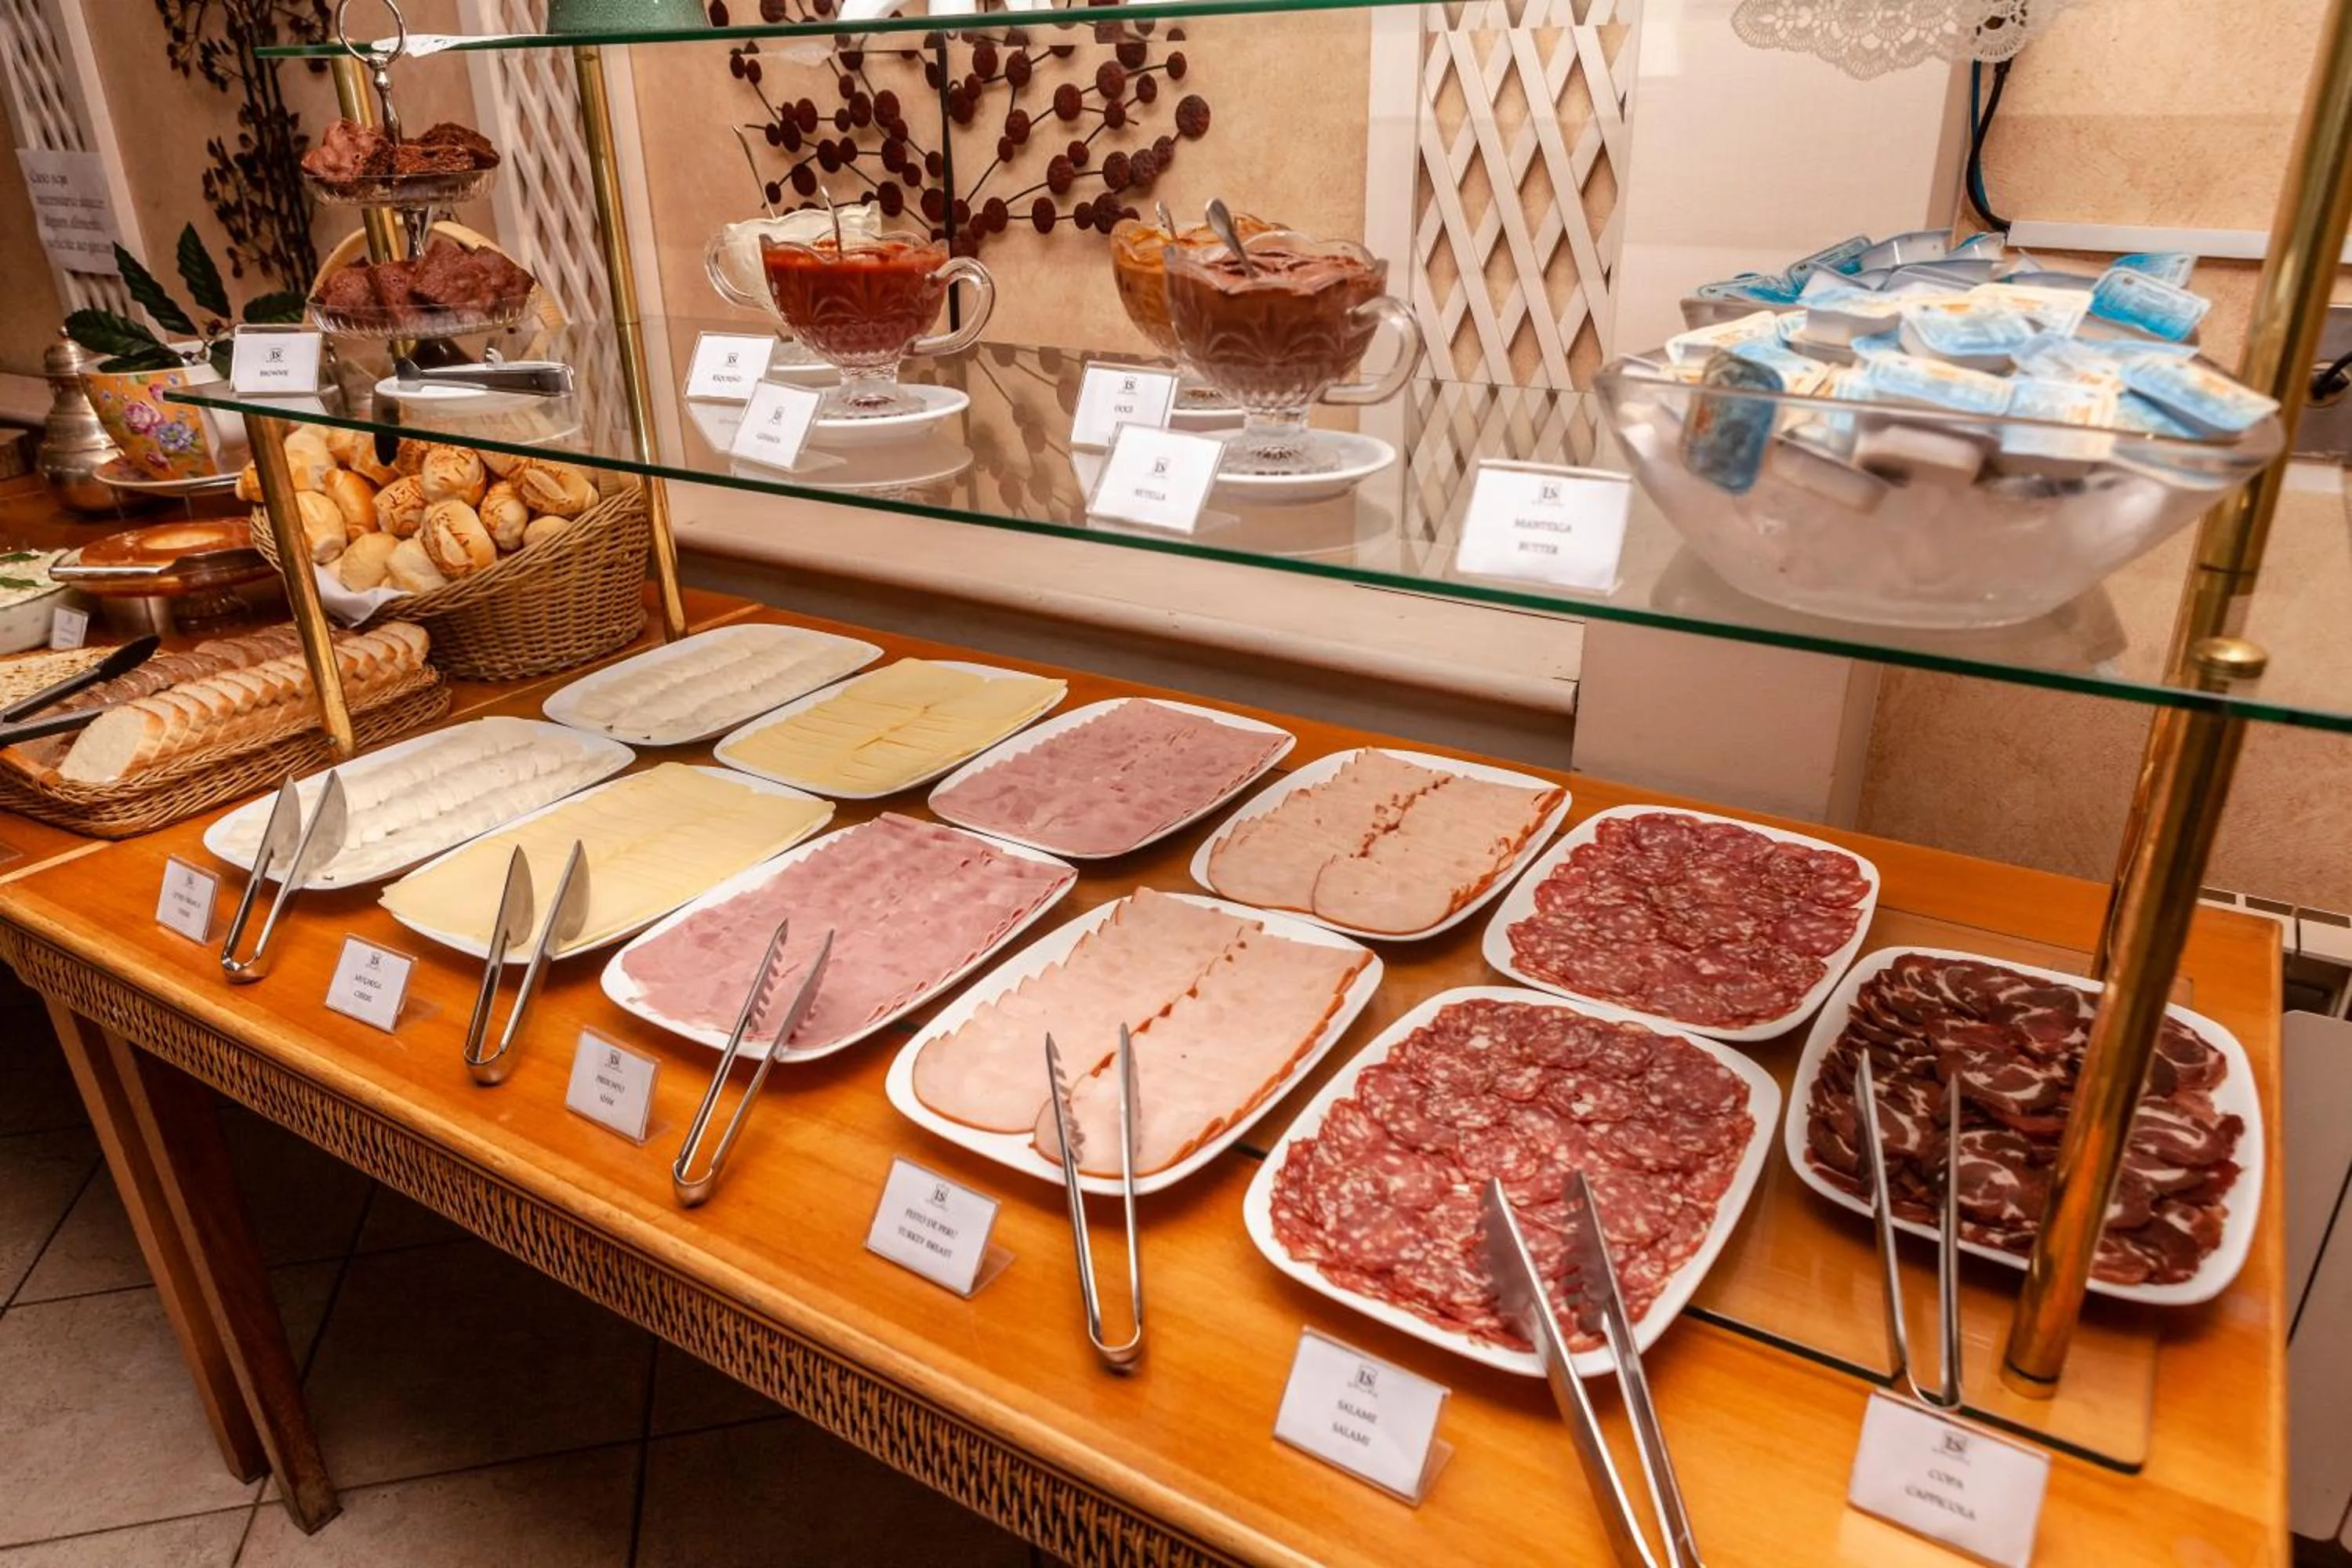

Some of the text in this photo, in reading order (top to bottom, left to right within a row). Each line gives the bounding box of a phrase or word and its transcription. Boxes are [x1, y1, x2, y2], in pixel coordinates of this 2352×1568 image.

[1337, 1399, 1378, 1424] SALAME
[1332, 1421, 1371, 1447] SALAMI
[1927, 1468, 1963, 1490] COPA
